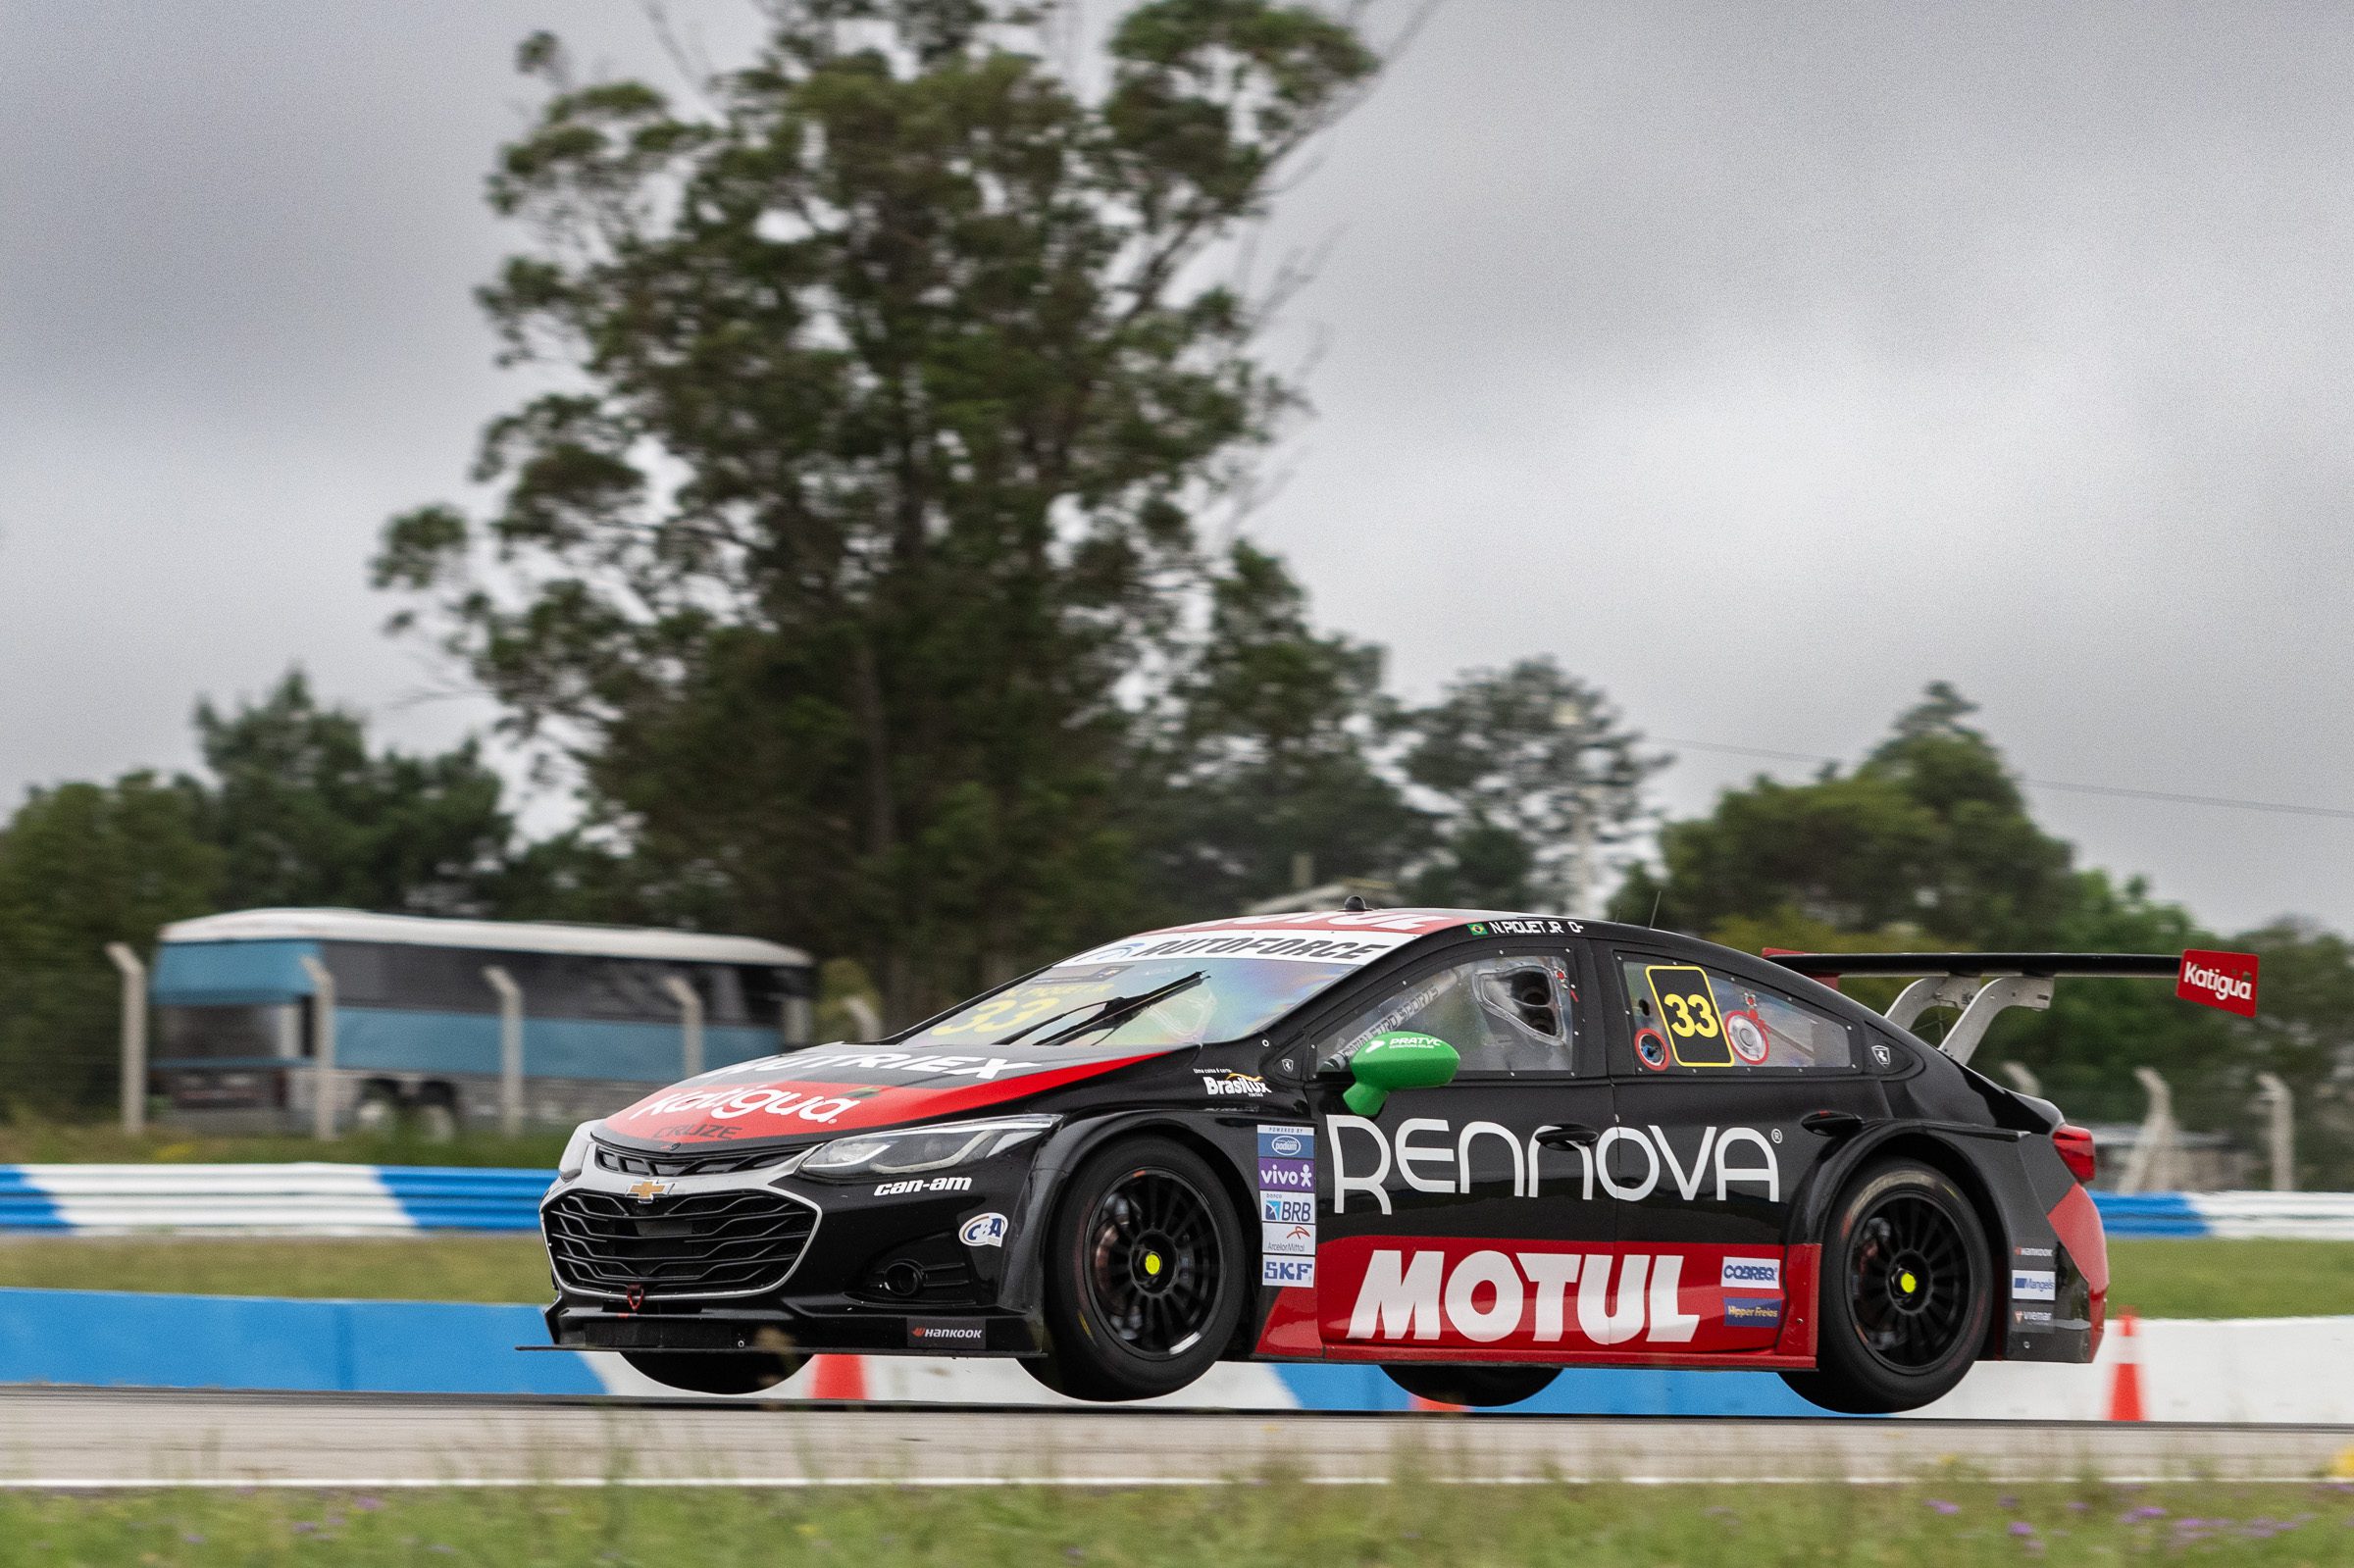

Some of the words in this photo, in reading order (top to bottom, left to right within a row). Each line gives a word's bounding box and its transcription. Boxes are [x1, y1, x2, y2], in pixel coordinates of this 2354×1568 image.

[1549, 922, 1564, 933] JR
[1132, 936, 1393, 960] AUTOFORCE
[2183, 961, 2252, 1000] Katigua
[931, 997, 1059, 1037] 33
[1664, 993, 1718, 1037] 33
[1390, 1037, 1443, 1046] PRATYC
[1203, 1077, 1272, 1094] Brasilux
[629, 1085, 861, 1123] Katigua
[652, 1124, 742, 1139] CRUZE
[1260, 1164, 1299, 1186] vivo
[1326, 1114, 1779, 1215] RENNOVA
[874, 1177, 973, 1196] can-am
[1281, 1201, 1311, 1222] BRB
[1268, 1241, 1305, 1252] ArcelorMittal
[1264, 1261, 1312, 1281] SKF
[1724, 1265, 1776, 1281] COBREQ
[1346, 1249, 1701, 1345] MOTUL
